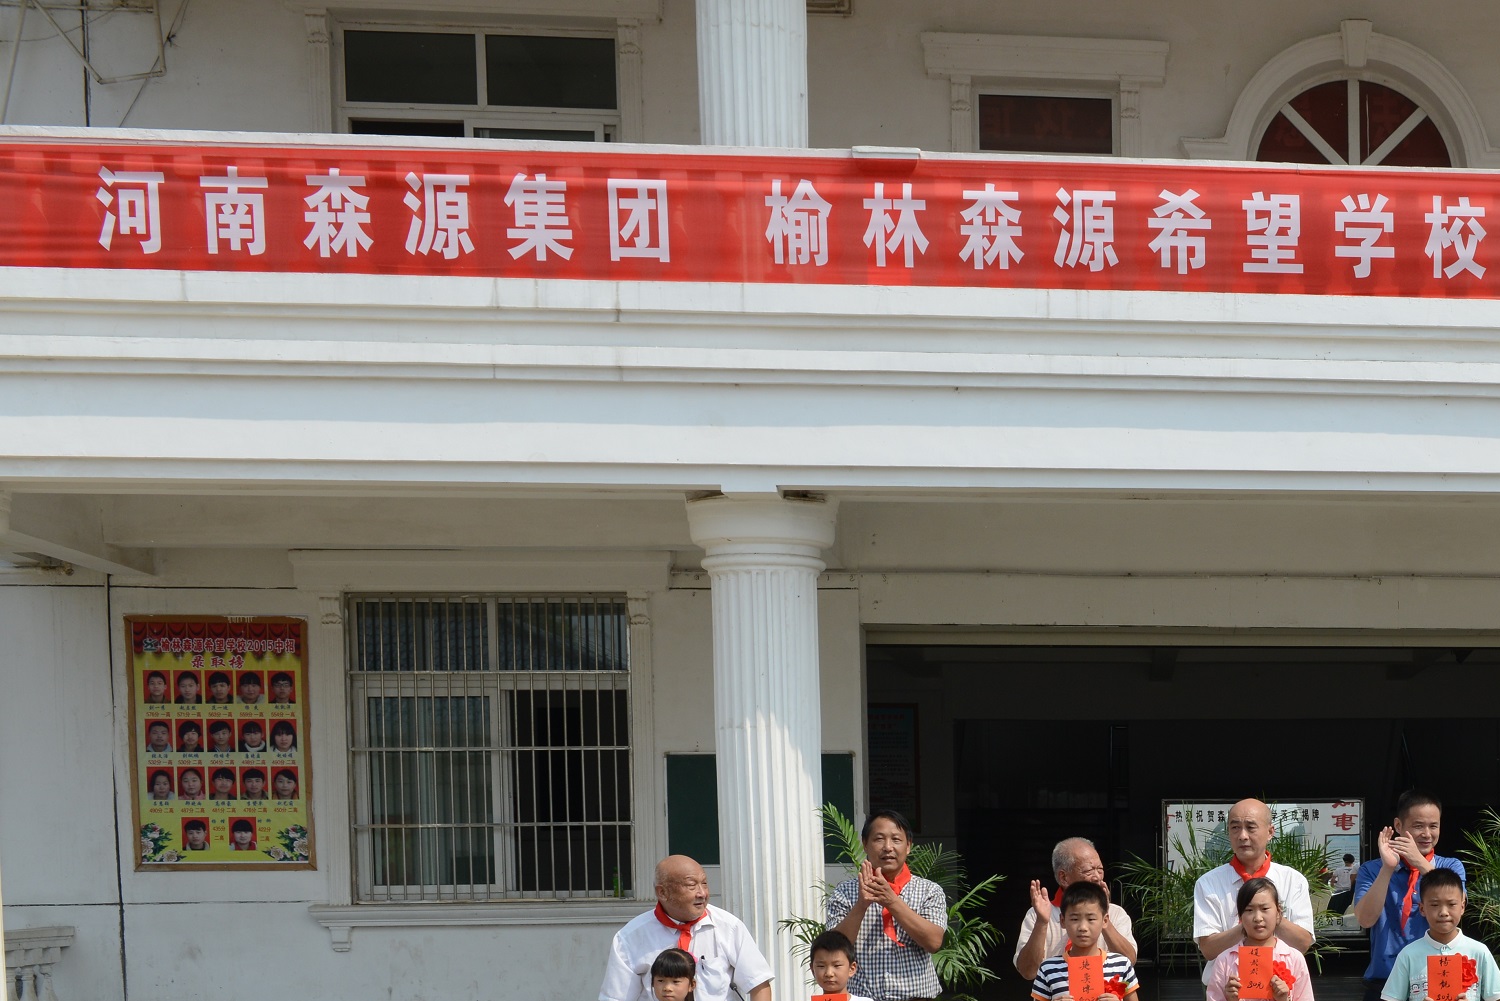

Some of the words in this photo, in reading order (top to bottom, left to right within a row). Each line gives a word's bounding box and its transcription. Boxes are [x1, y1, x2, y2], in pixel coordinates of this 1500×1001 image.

[96, 165, 671, 263] 河南森源集团
[1175, 808, 1320, 823] 热烈祝贺森学落成揭牌
